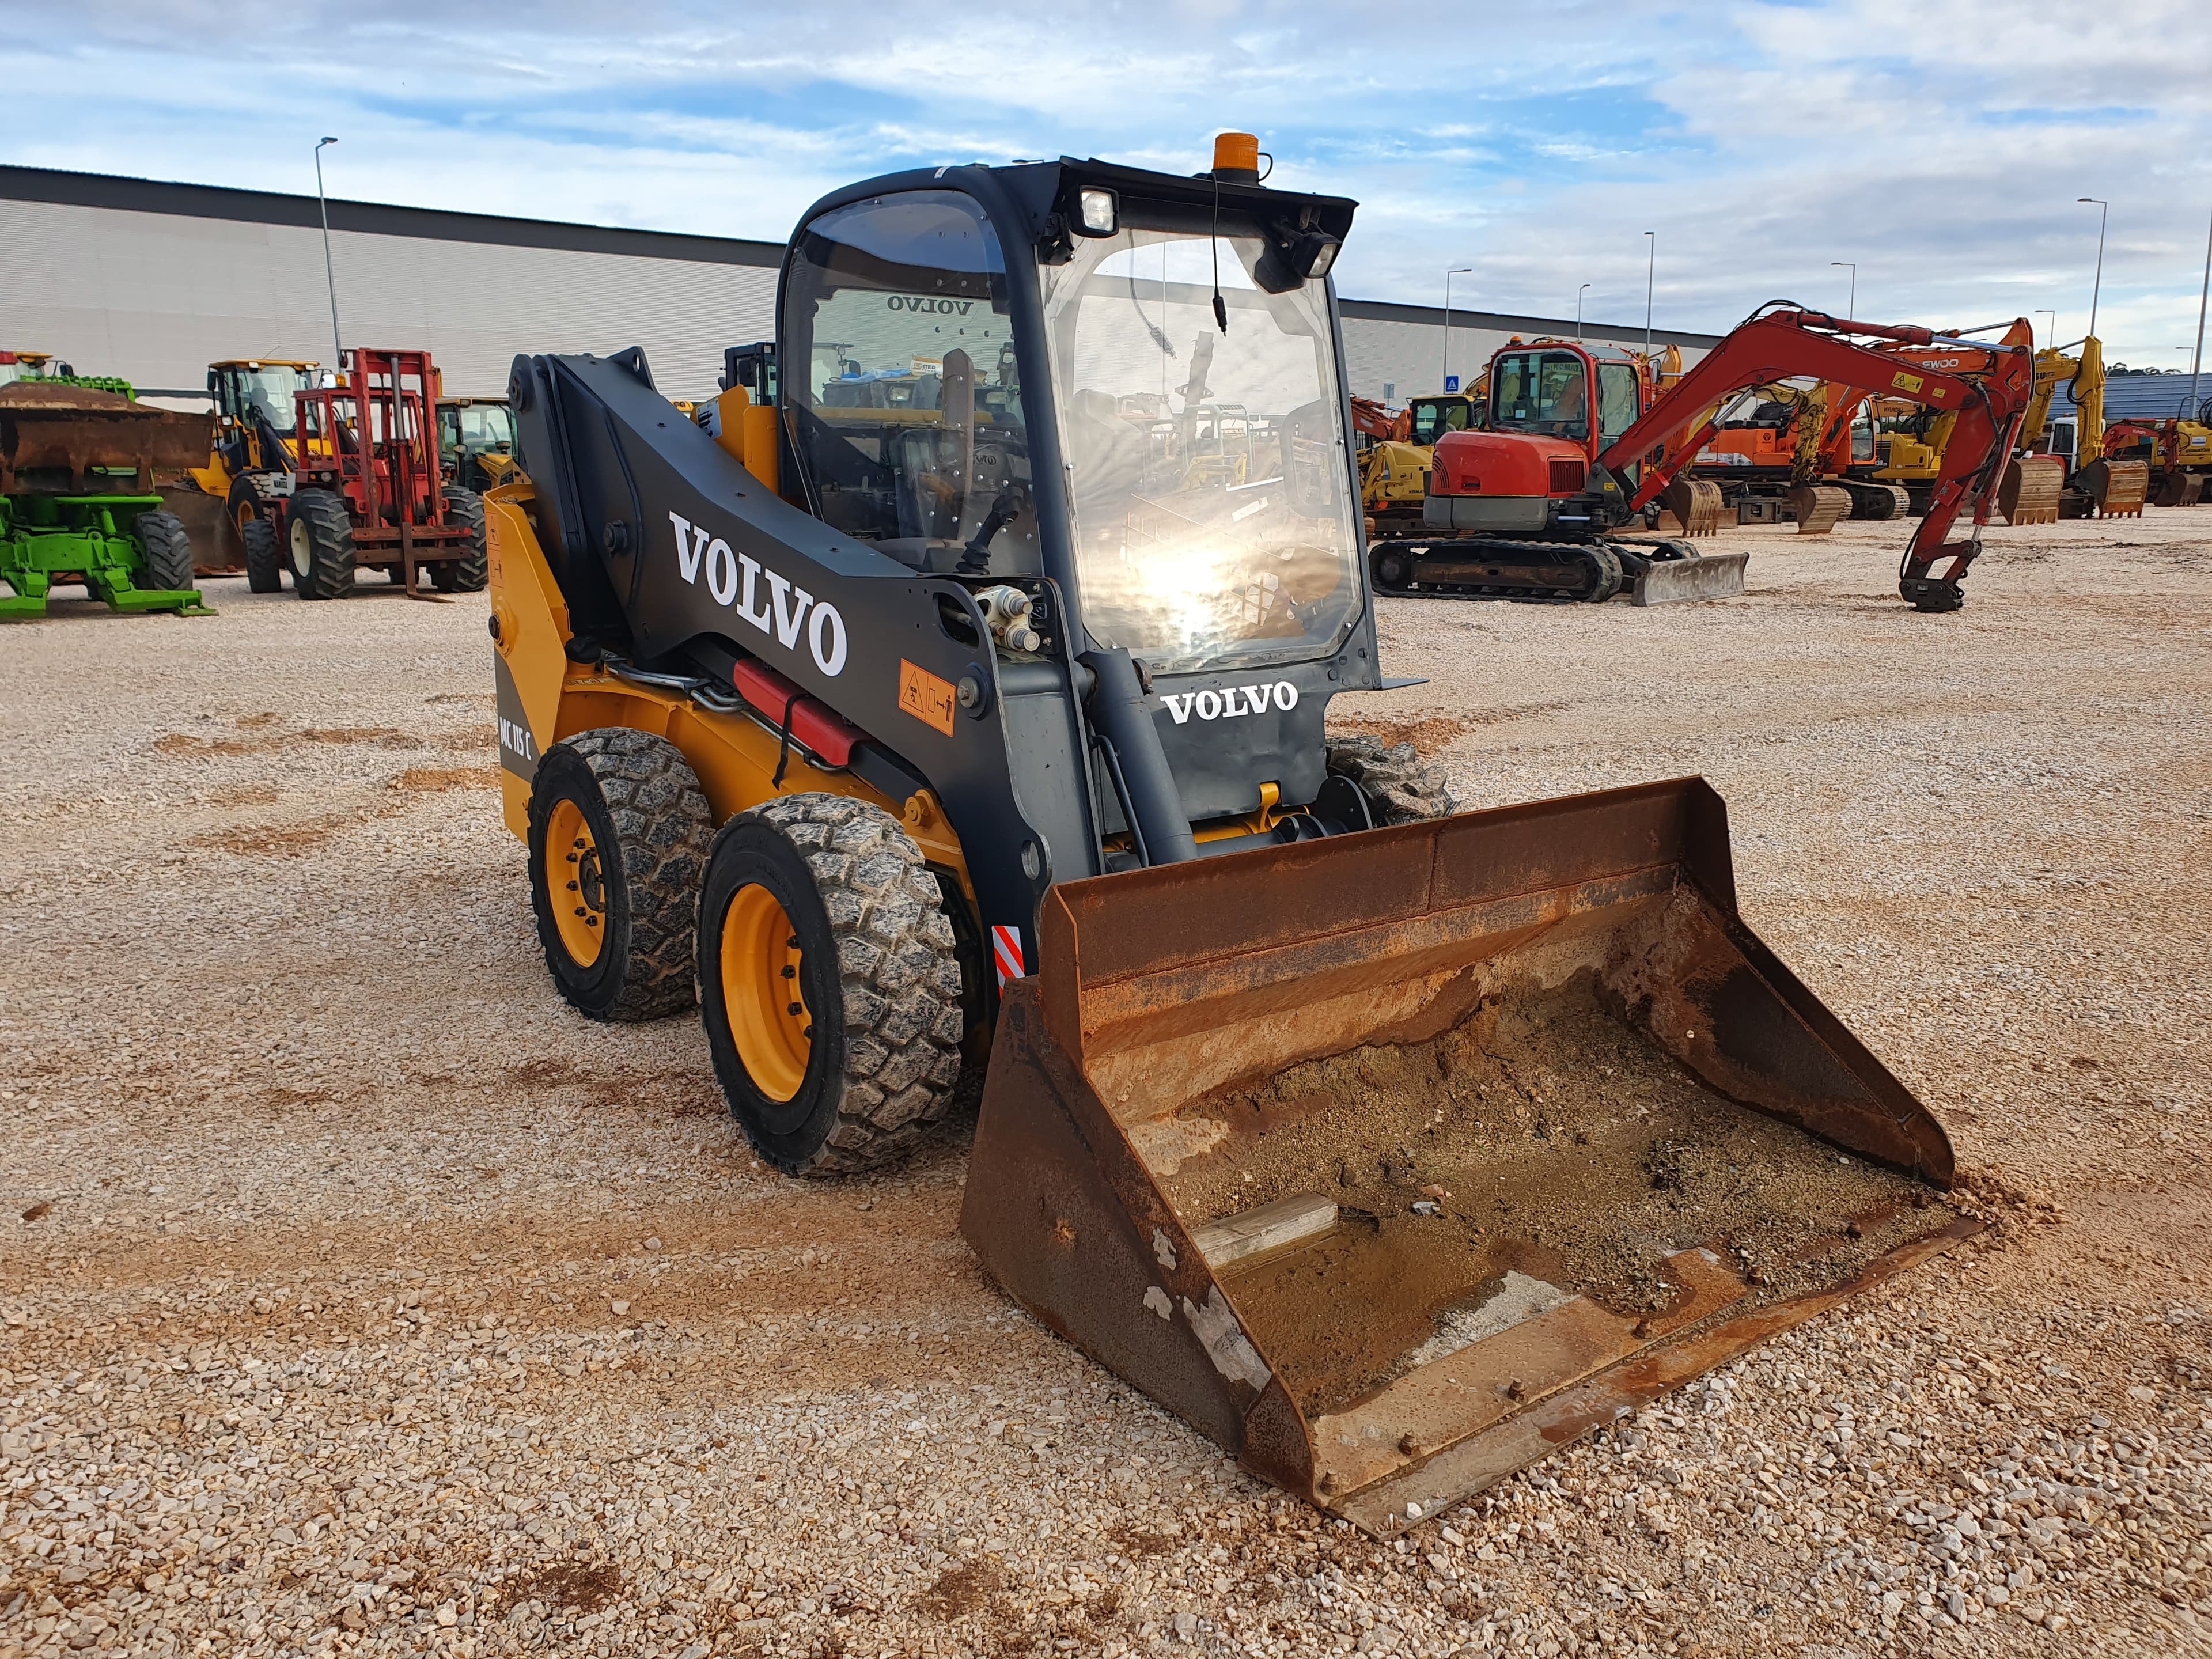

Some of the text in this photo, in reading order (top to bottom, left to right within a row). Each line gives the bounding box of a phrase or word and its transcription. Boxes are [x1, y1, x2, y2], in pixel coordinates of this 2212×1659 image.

[1922, 359, 1959, 369] EWOO
[669, 510, 847, 677] VOLVO
[1160, 681, 1299, 724] VOLVO
[499, 716, 532, 761] MC 115 C
